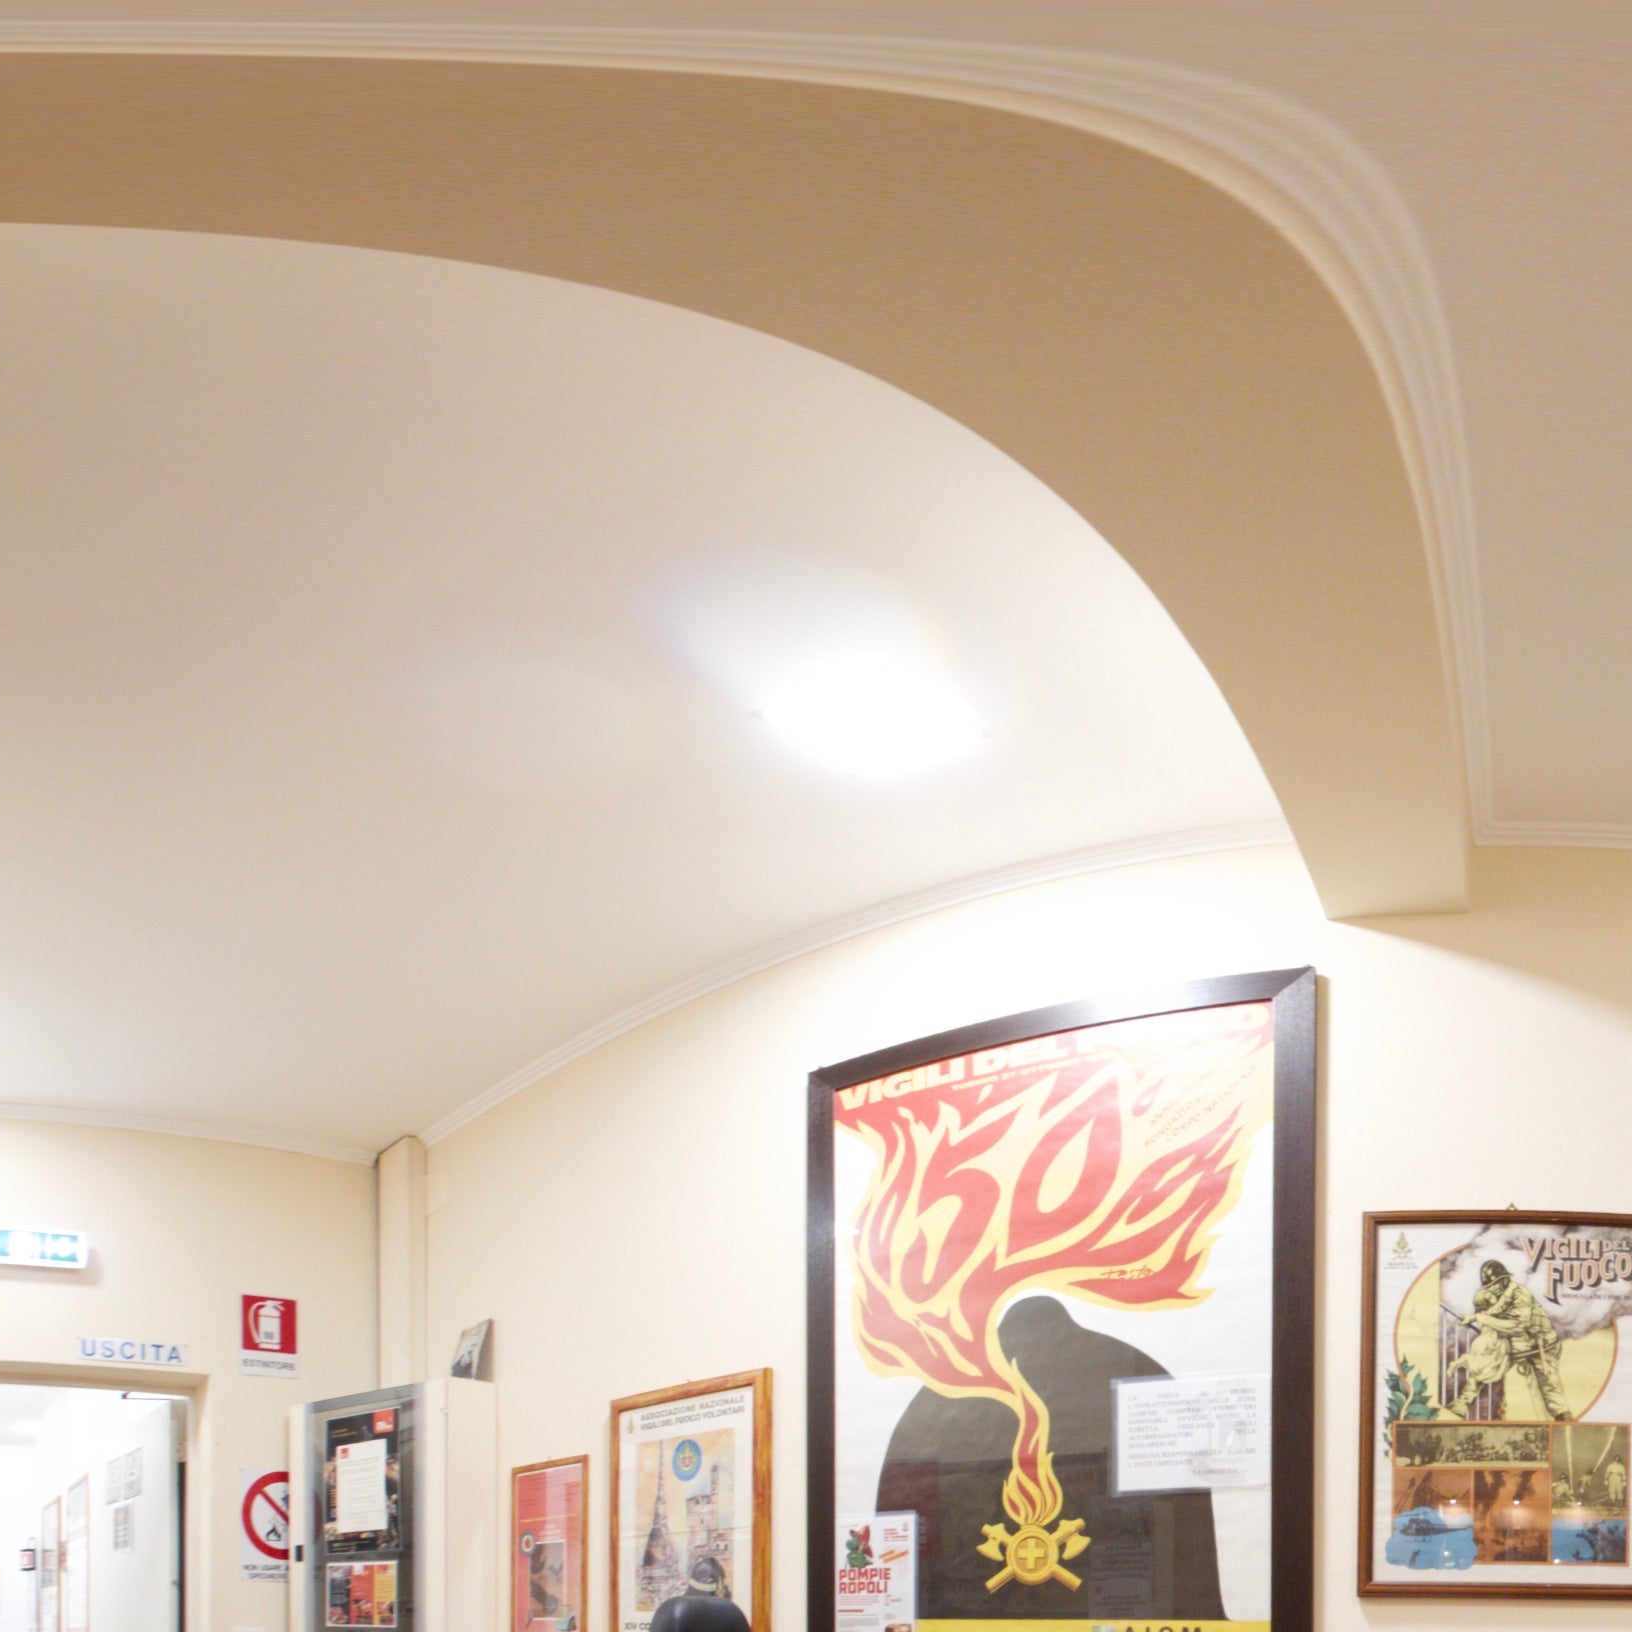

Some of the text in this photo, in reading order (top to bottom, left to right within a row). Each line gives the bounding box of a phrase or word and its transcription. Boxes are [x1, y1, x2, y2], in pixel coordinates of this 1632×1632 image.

[837, 1031, 1067, 1111] VIGILI DEL
[1521, 1238, 1630, 1272] VIGILI DEL
[80, 1337, 183, 1364] USCITA
[838, 1567, 891, 1581] POMPIE
[838, 1582, 889, 1595] ROPOLI
